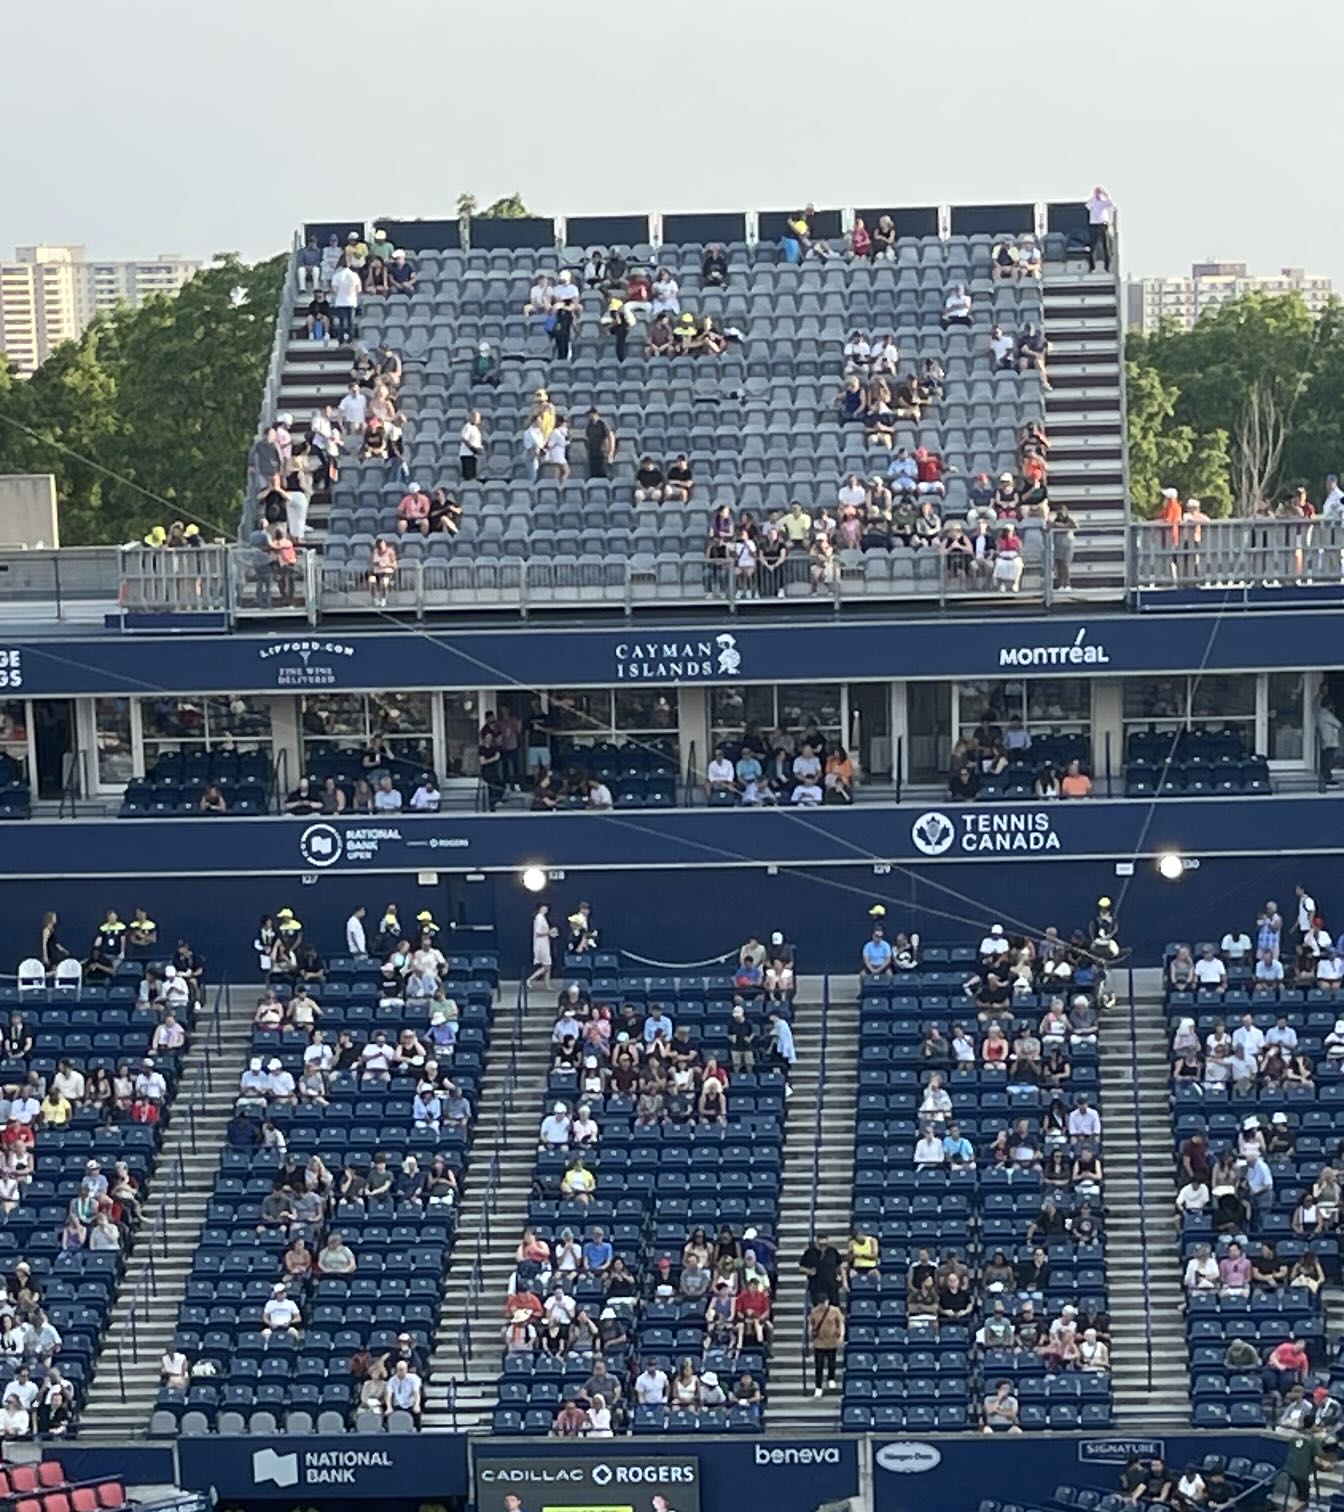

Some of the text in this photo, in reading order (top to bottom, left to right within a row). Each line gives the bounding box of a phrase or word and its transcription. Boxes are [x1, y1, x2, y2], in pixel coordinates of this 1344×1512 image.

[616, 643, 712, 660] CAYMAN
[617, 661, 712, 678] ISLANDS
[962, 813, 1049, 832] TENNIS
[346, 829, 401, 840] NATIONAL
[962, 831, 1060, 852] CANADA
[346, 839, 378, 851] BANK
[439, 839, 469, 847] ROGERS
[347, 851, 372, 860] OPEN
[305, 1452, 393, 1467] NATIONAL
[755, 1443, 839, 1465] beneva
[306, 1468, 356, 1483] BANK
[481, 1469, 584, 1482] CADILLAC
[617, 1466, 695, 1483] ROGERS
